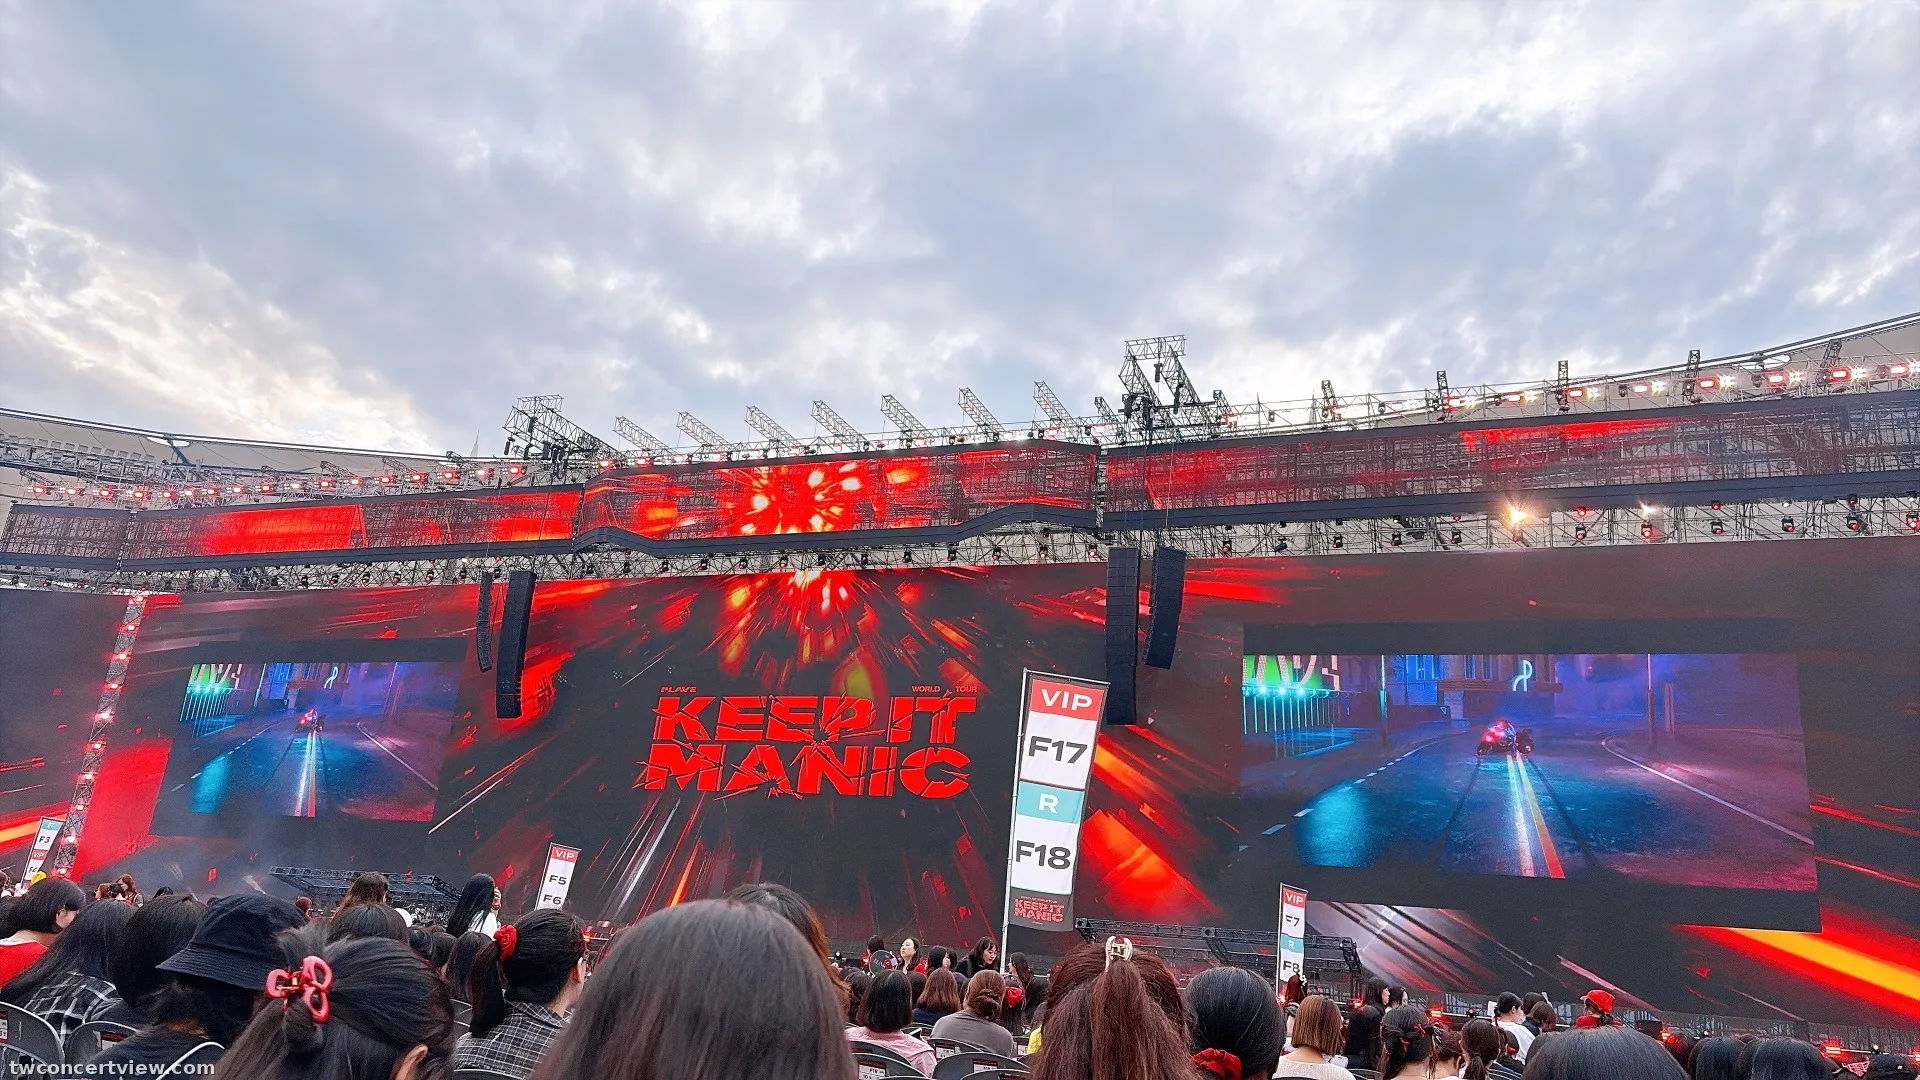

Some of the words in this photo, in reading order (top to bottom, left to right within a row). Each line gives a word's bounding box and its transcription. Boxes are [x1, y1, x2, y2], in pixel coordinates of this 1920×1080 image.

[660, 685, 697, 693] PLAVE
[911, 685, 941, 693] WORLD
[955, 685, 978, 693] TOUR
[1040, 688, 1093, 712] VIP
[652, 695, 879, 743] KEEP
[887, 694, 977, 744] IT
[1028, 735, 1088, 764] F17
[636, 745, 972, 800] MANIC
[1038, 792, 1060, 814] R
[38, 836, 51, 844] F3
[555, 849, 575, 859] VIP
[1015, 840, 1071, 870] F18
[548, 874, 567, 886] F5
[542, 894, 562, 905] F6
[1285, 892, 1304, 904] VIP
[1015, 898, 1049, 912] KEEP
[1049, 904, 1065, 915] IT
[1014, 907, 1064, 923] MANIC
[1285, 914, 1300, 927] F7
[1288, 940, 1295, 949] R
[1282, 960, 1300, 973] F8
